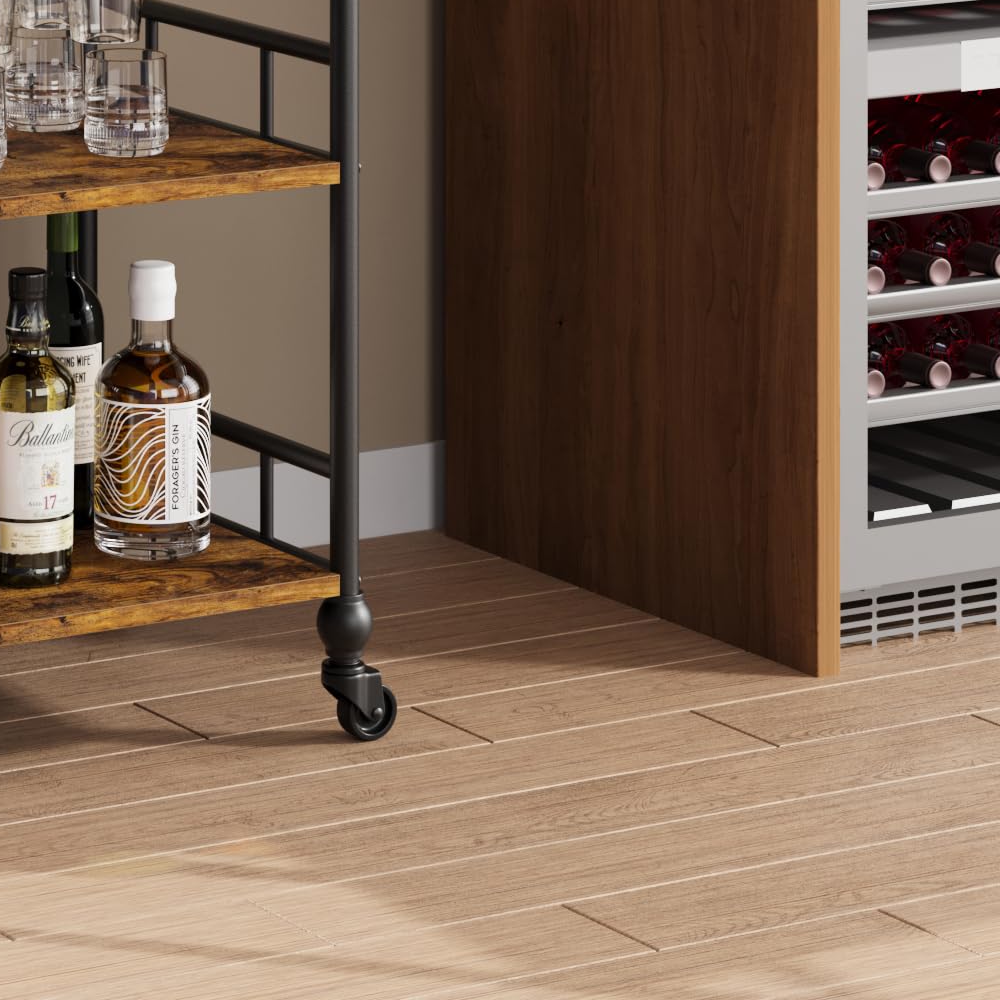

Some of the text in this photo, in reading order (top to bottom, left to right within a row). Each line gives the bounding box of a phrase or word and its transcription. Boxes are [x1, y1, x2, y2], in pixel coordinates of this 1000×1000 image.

[76, 354, 93, 367] WIFE
[171, 424, 179, 510] FORAGER'S GIN
[43, 494, 57, 510] 17
